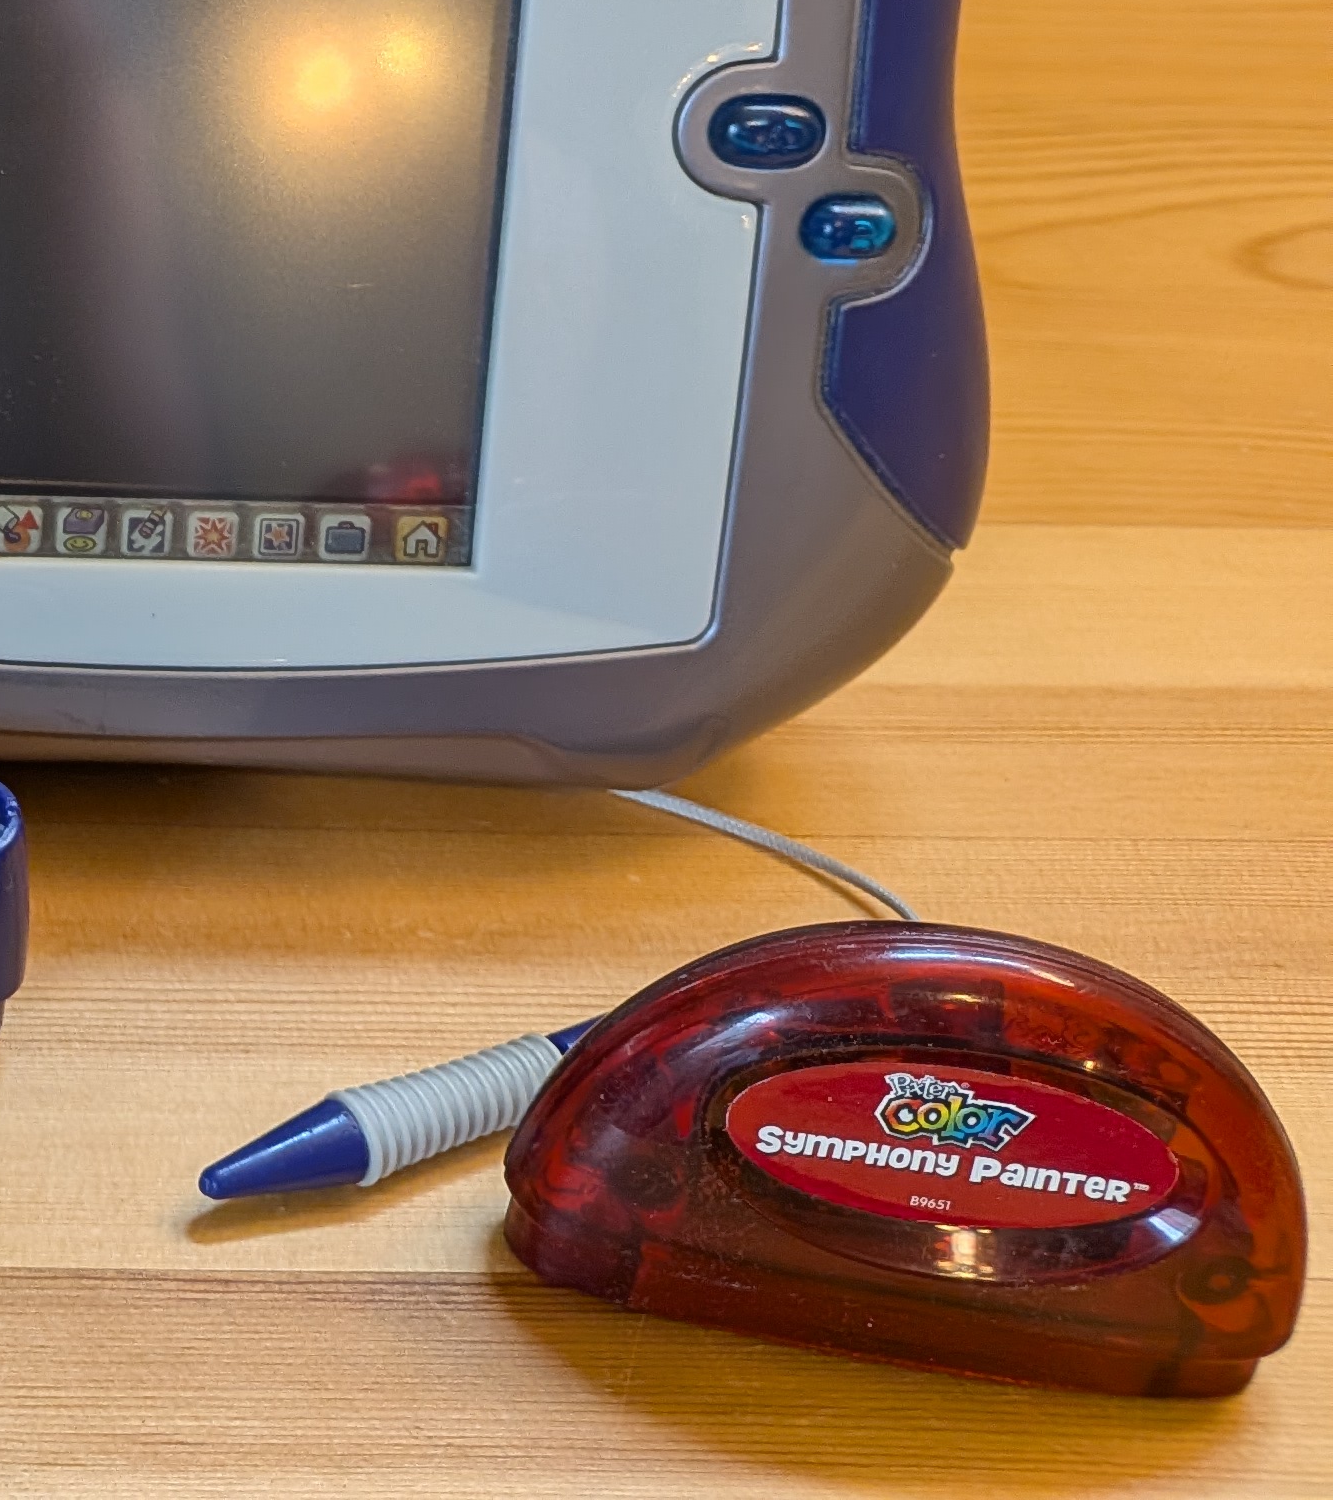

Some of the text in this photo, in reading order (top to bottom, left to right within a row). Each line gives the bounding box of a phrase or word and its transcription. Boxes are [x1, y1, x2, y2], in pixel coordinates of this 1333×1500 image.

[887, 1073, 958, 1100] Pixter
[755, 1124, 962, 1178] Symphony
[910, 1195, 951, 1211] B9651
